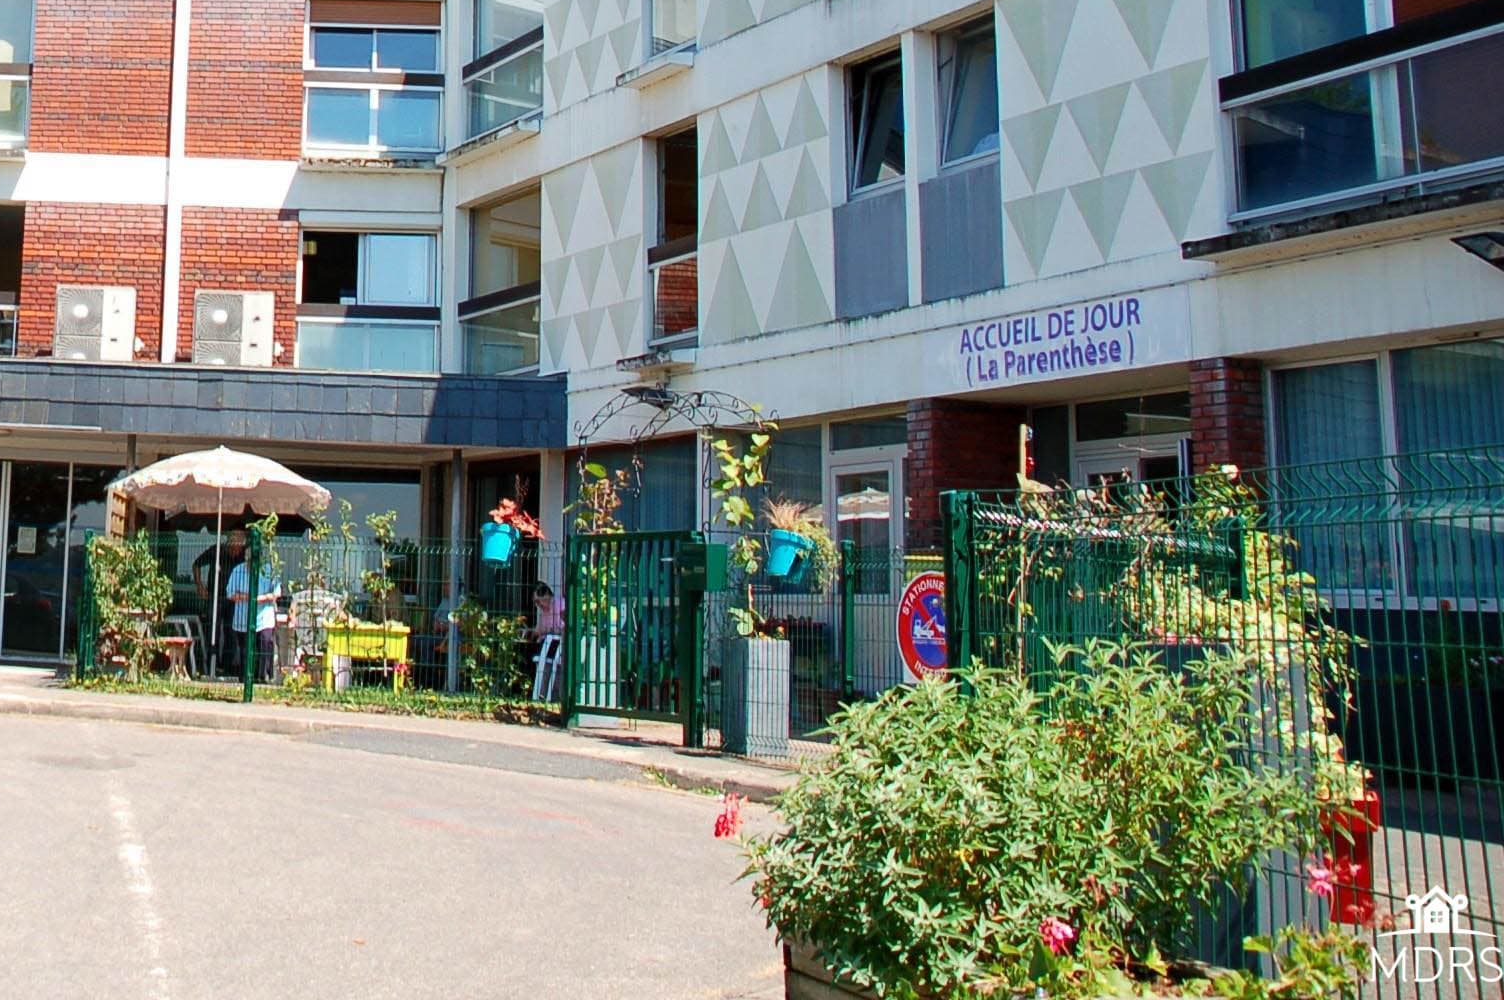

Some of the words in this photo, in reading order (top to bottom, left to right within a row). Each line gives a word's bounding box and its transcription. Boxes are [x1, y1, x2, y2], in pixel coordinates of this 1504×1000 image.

[960, 316, 1042, 354] ACCUEIL
[1047, 309, 1075, 340] DE
[1081, 298, 1141, 334] JOUR
[977, 355, 999, 382] La
[1004, 336, 1122, 378] Parenthèse
[902, 579, 945, 616] STATIONNE
